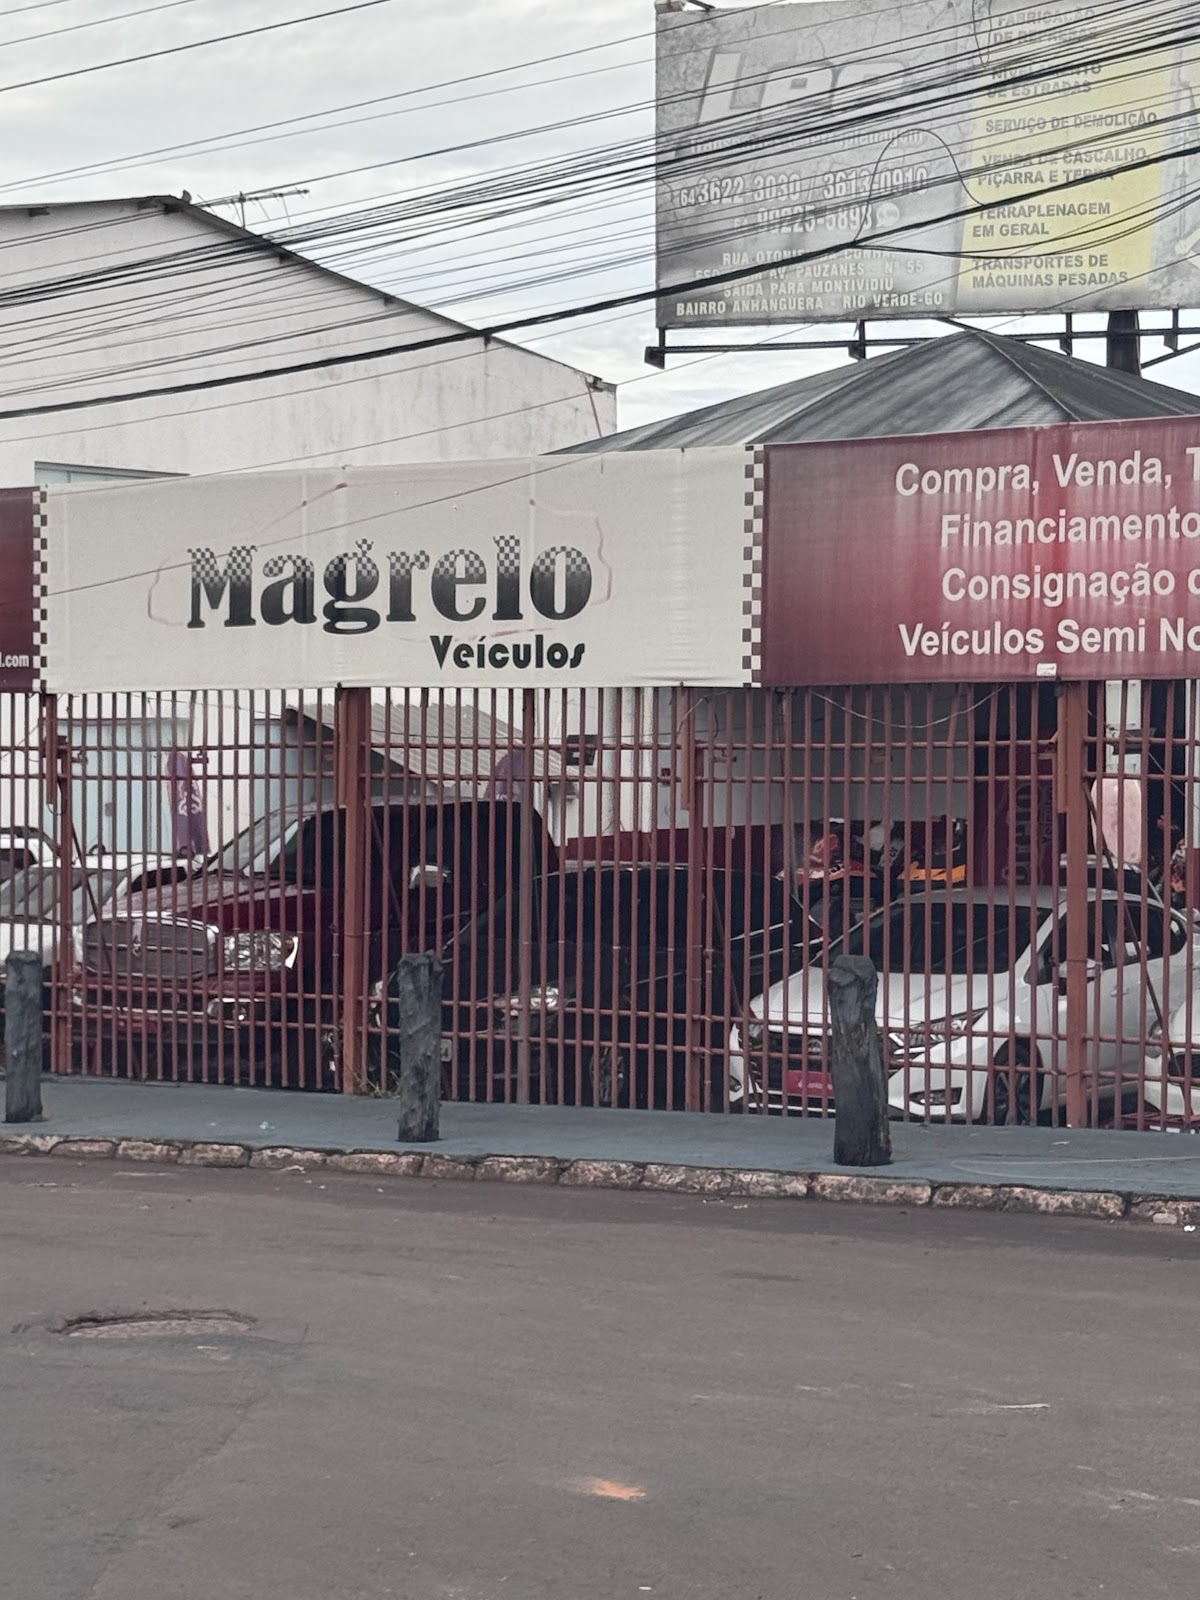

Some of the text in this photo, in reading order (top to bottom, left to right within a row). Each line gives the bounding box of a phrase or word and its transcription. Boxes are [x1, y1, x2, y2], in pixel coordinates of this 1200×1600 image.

[993, 30, 1013, 43] DE
[986, 110, 1157, 133] SERVIÇO DE DEMOLIÇÃO
[978, 170, 1045, 187] PIÇARRA
[1050, 169, 1059, 183] E
[977, 201, 1111, 221] TERRAPLENAGEM
[973, 223, 1050, 238] EM GERAL
[722, 251, 750, 267] RUA
[973, 254, 1109, 271] TRANSPORTES DE
[796, 262, 865, 280] PAUZANES
[907, 260, 924, 274] 55
[973, 271, 1128, 289] MÁQUINAS PESADAS
[770, 281, 805, 297] PARA
[811, 278, 894, 295] MONTIVIDIU
[676, 301, 726, 316] BAIRRO
[732, 297, 823, 313] ANHANGUERA
[843, 294, 866, 310] RIO
[872, 291, 943, 309] VERDE-GO
[895, 462, 1040, 500] Compra,
[1052, 450, 1172, 489] Venda,
[941, 505, 1200, 547] Financiamento
[187, 534, 592, 634] Magrelo
[942, 562, 1176, 607] Consignação
[898, 621, 1045, 657] Veículos
[1056, 618, 1146, 654] Semi
[429, 634, 585, 670] Veículos
